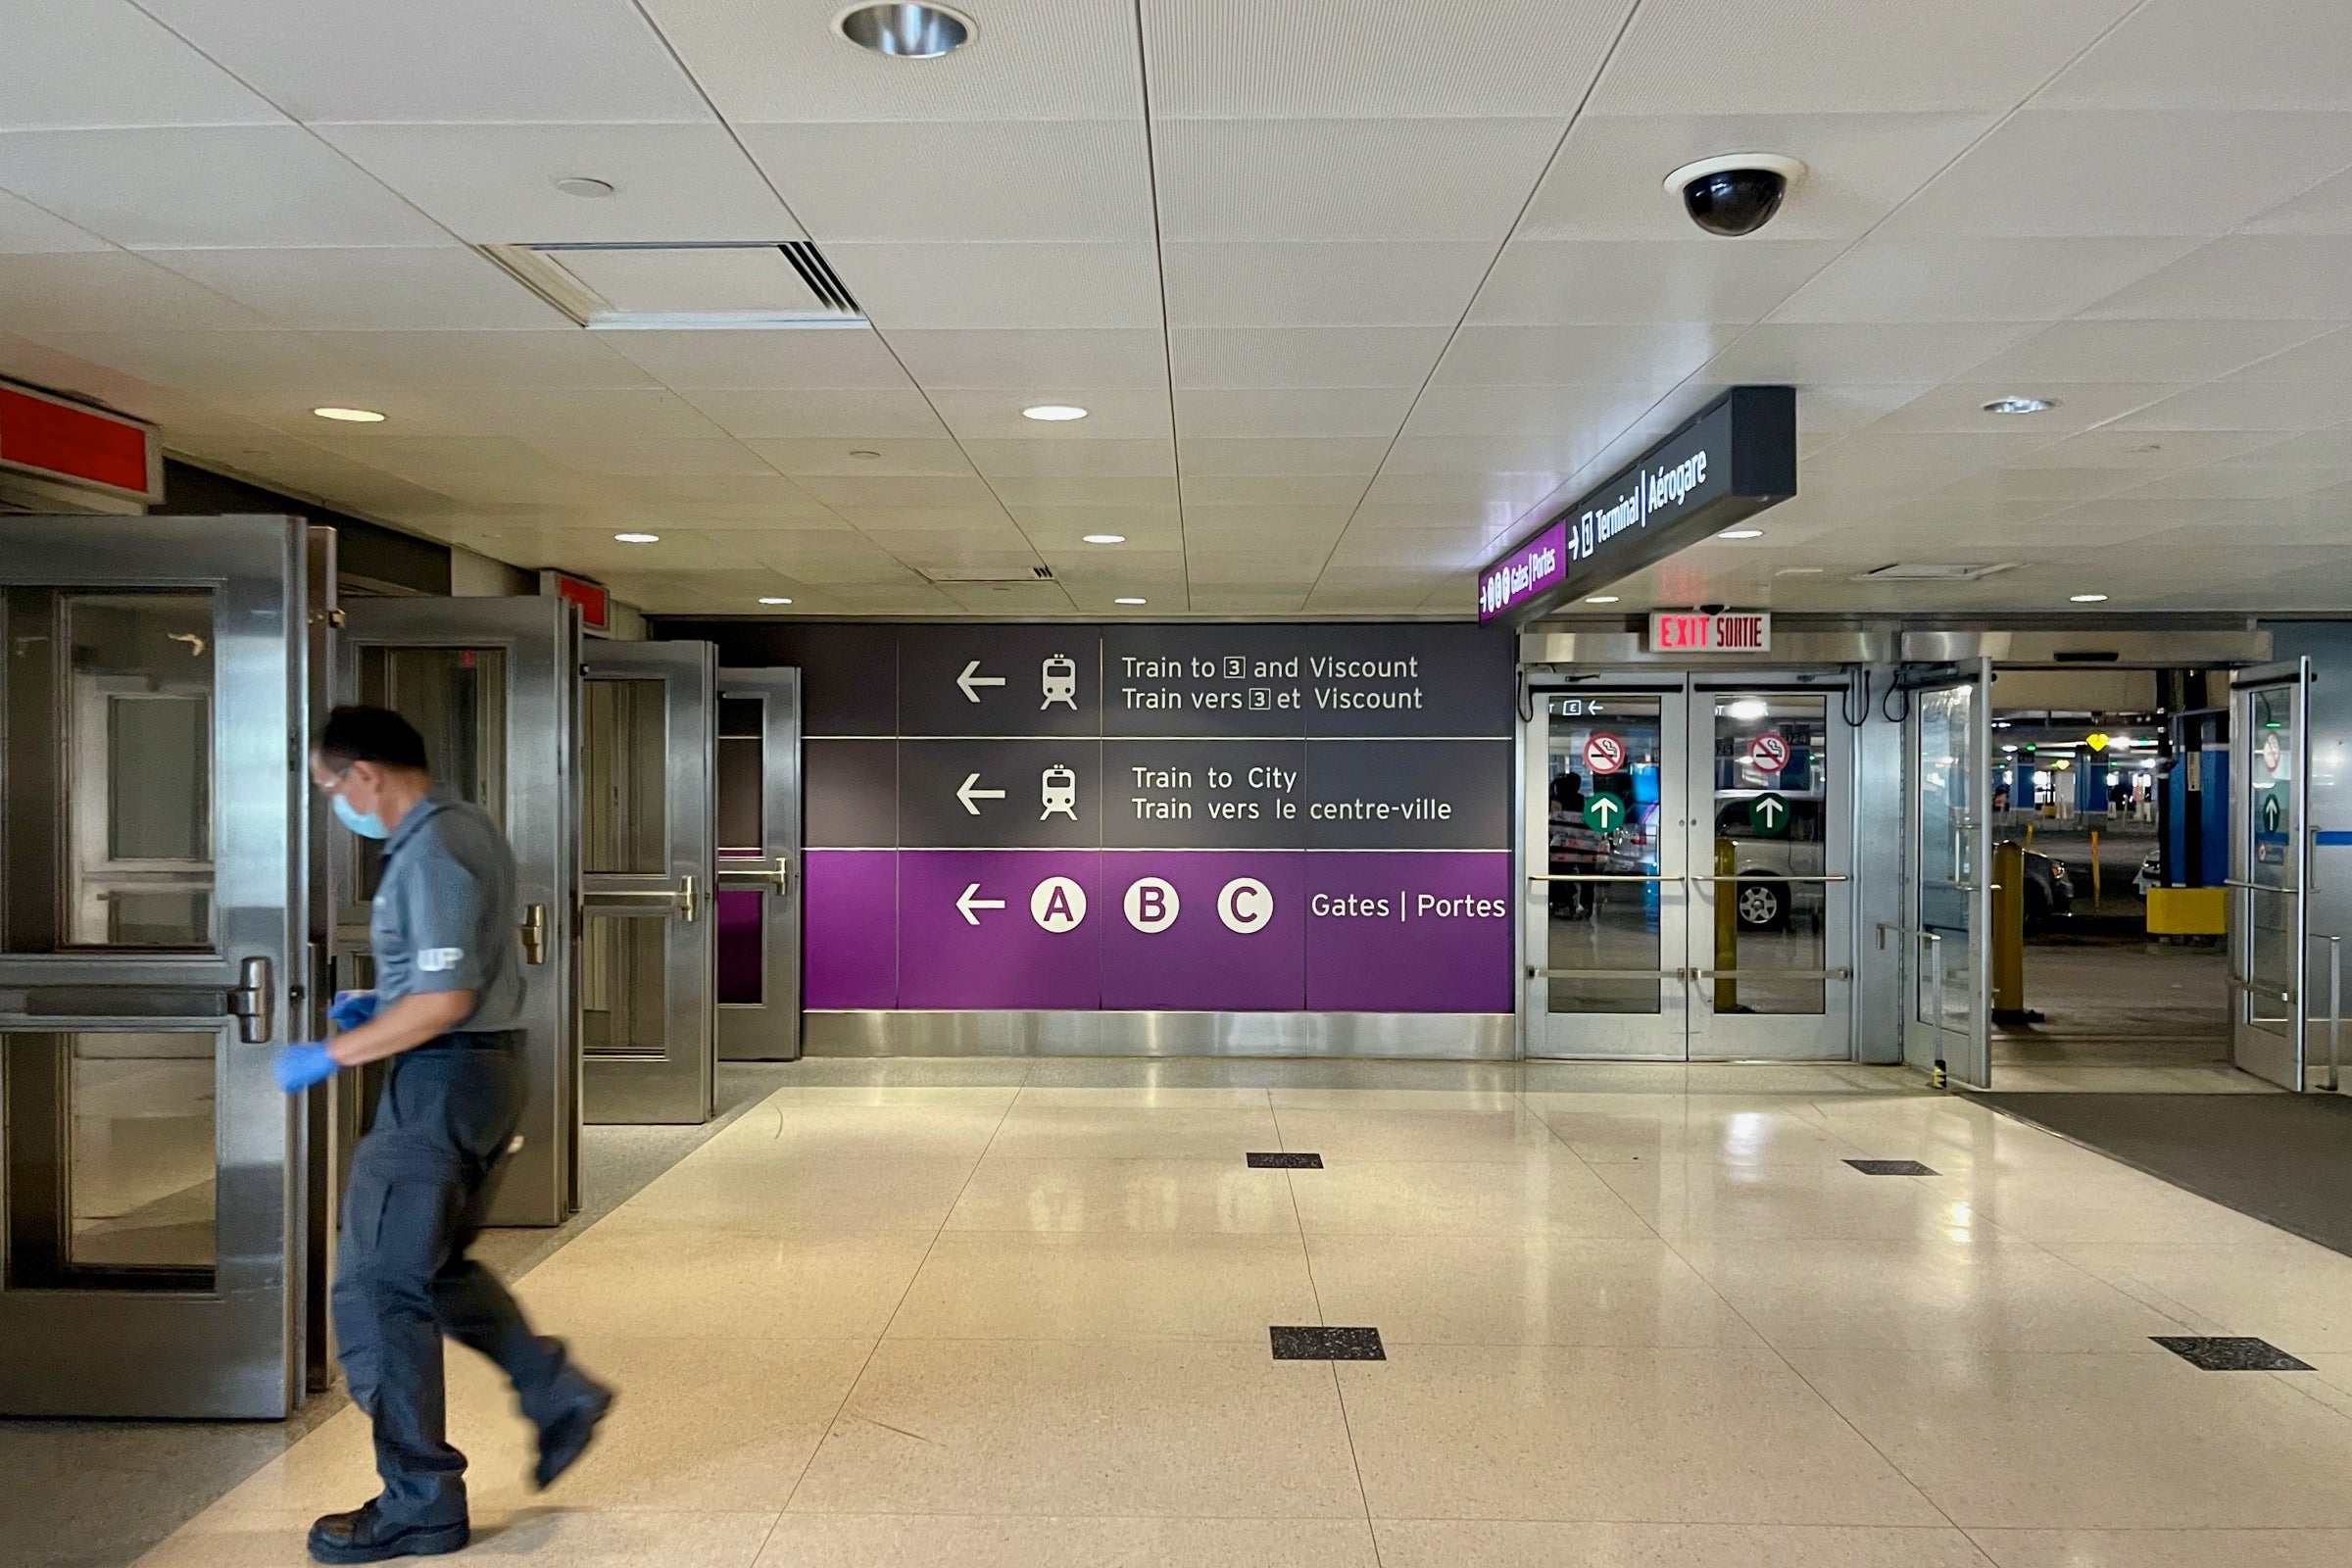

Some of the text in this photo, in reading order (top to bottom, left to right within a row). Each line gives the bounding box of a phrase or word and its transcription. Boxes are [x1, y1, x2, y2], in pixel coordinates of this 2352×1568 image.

[1595, 485, 1640, 543] Terminal
[1647, 450, 1707, 513] Aérogare
[1532, 546, 1555, 582] Portes
[1659, 615, 1762, 648] EXIT SORTIE
[1122, 656, 1182, 678] Train
[1191, 658, 1215, 678] to
[1253, 657, 1298, 678] and
[1310, 656, 1418, 678] Viscount
[1122, 688, 1182, 710] Train
[1191, 692, 1243, 710] vers
[1277, 688, 1301, 710] et
[1315, 687, 1423, 710] Viscount
[1132, 766, 1298, 794] Train to City
[1132, 797, 1452, 820] Train vers le centre-ville
[1042, 885, 1506, 923] A B C Gates Portes
